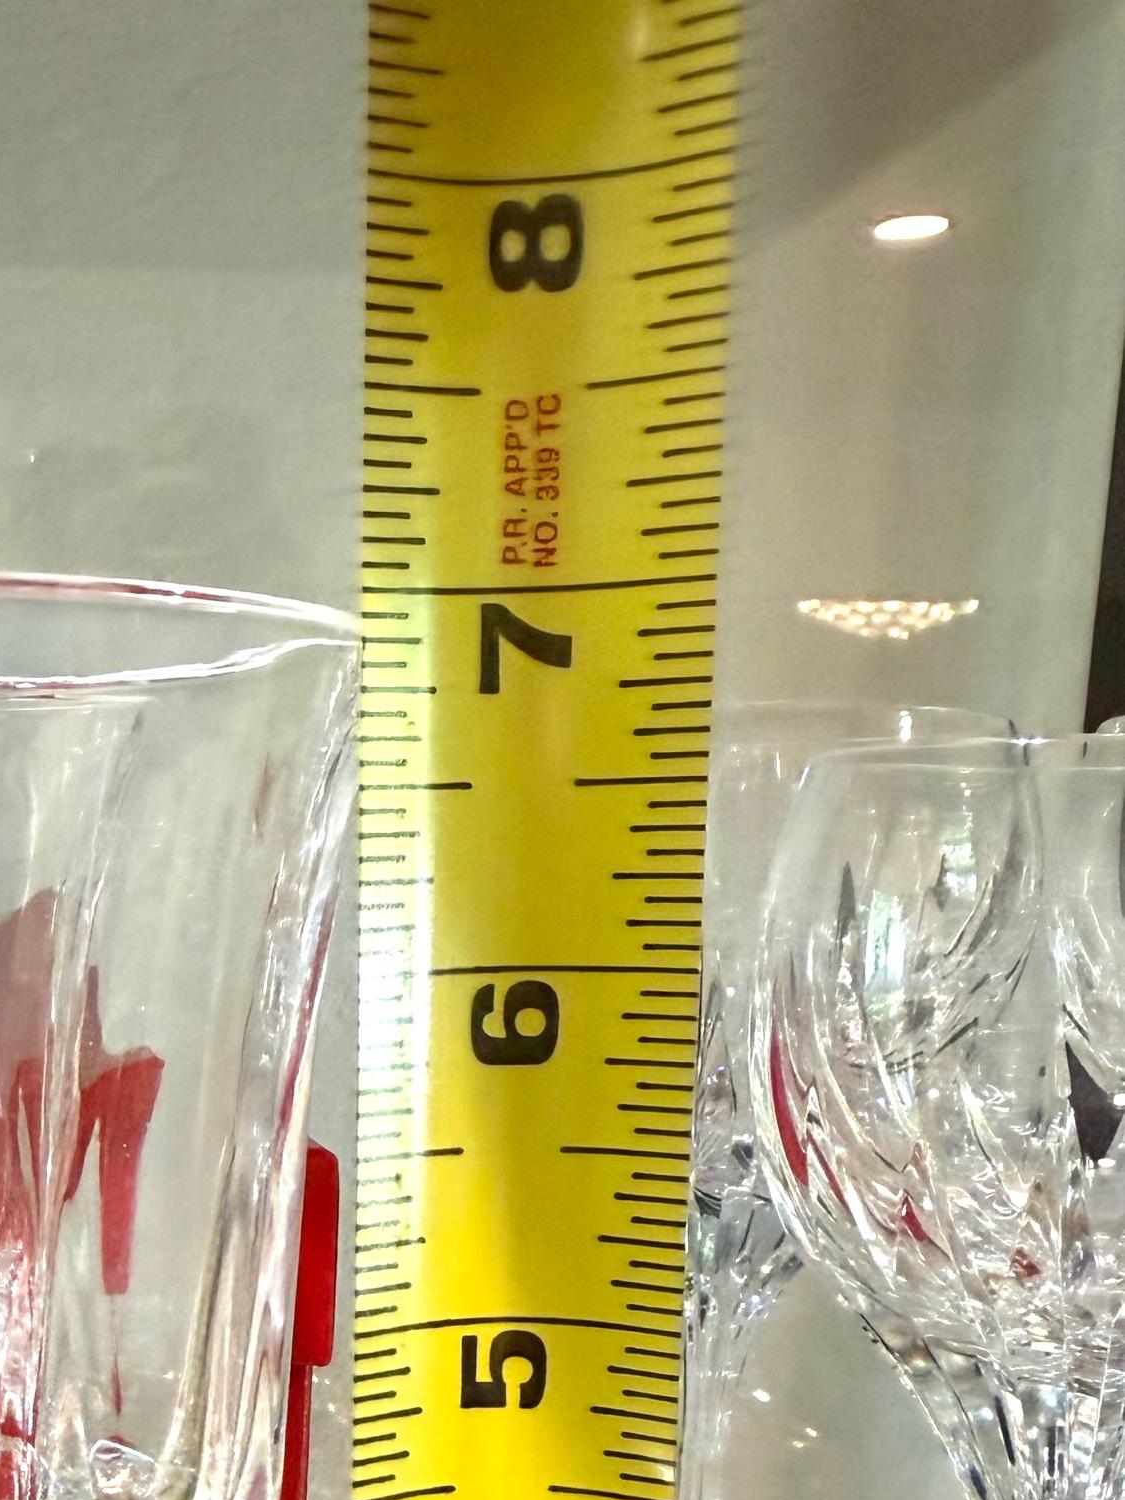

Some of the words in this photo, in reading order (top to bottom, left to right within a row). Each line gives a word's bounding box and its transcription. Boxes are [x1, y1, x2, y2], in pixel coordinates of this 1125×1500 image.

[489, 193, 583, 292] 8
[504, 399, 529, 497] APP'D
[535, 393, 562, 437] TC
[532, 511, 560, 568] NO.
[478, 603, 572, 694] 7
[470, 980, 560, 1066] 6
[460, 1329, 547, 1409] 5
